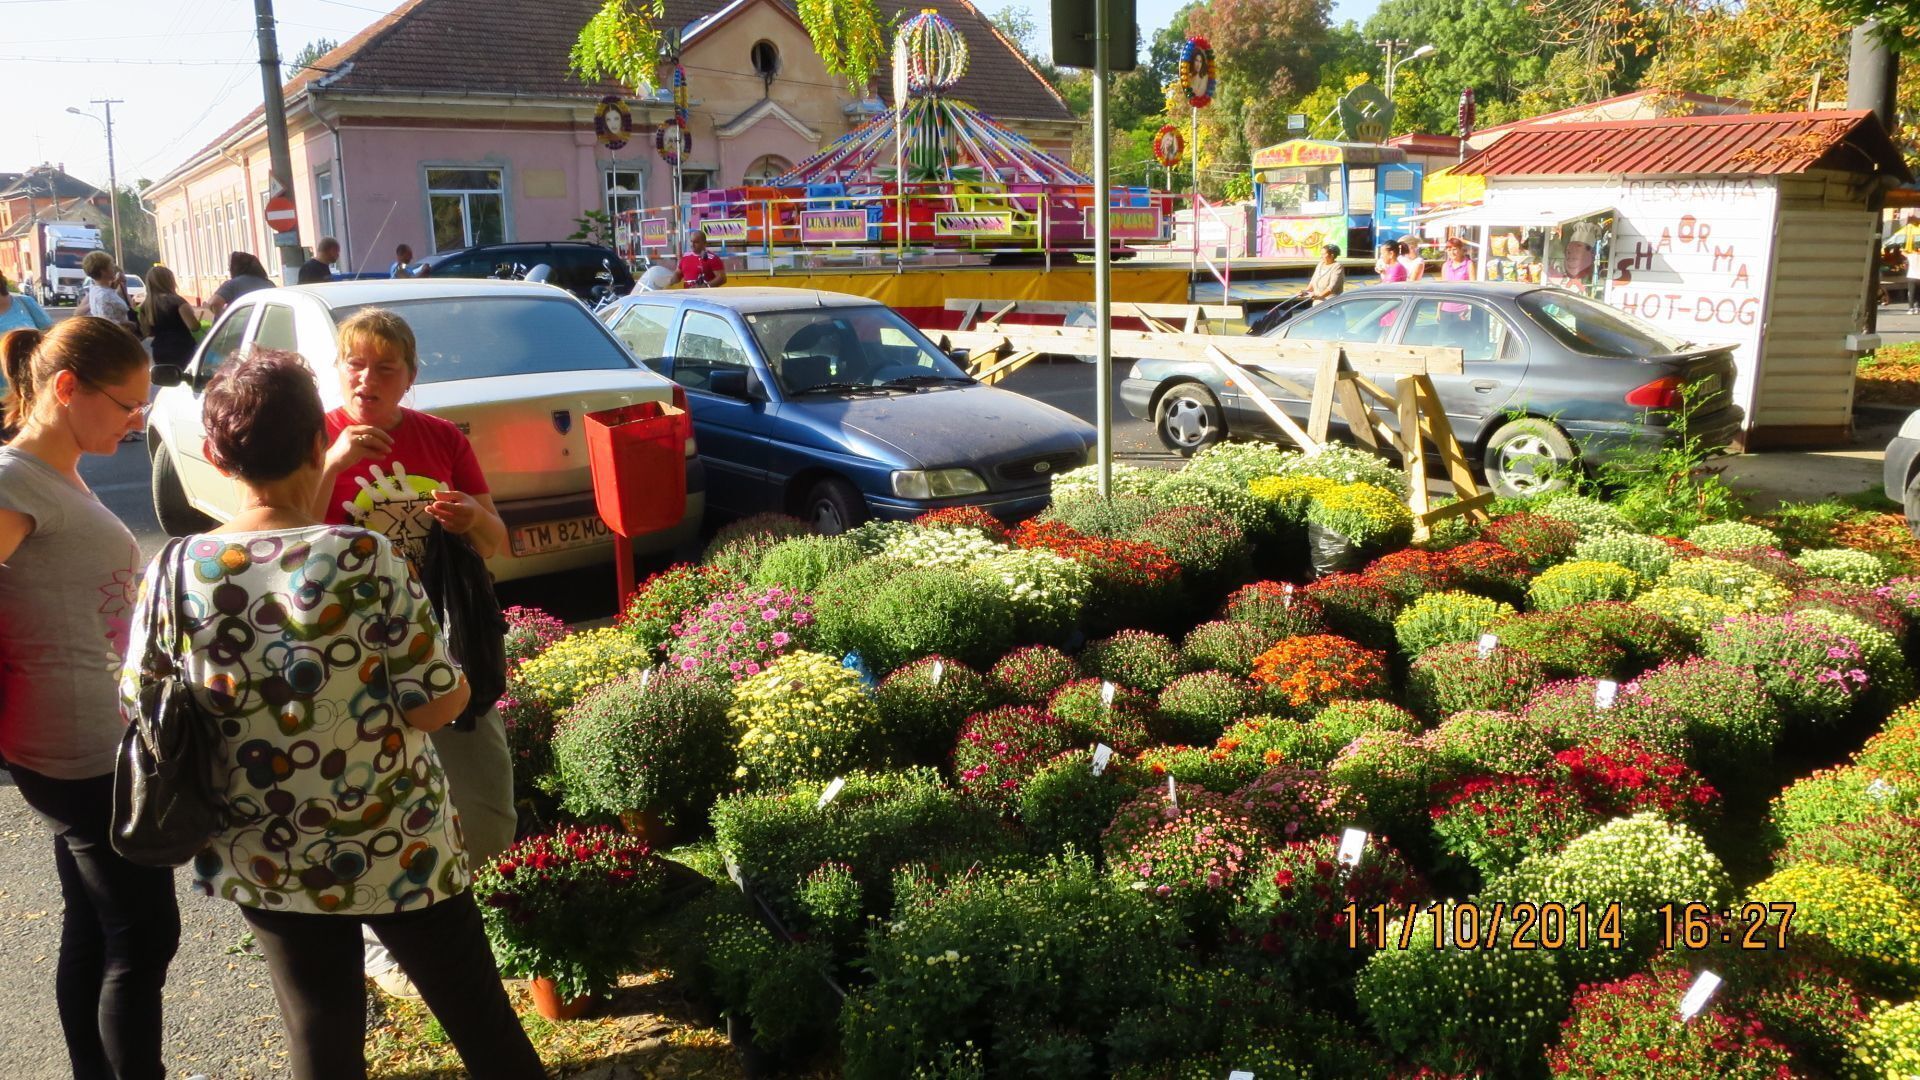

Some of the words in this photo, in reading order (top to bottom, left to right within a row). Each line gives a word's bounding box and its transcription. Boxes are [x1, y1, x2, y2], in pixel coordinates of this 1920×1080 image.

[806, 215, 831, 229] LUNA
[1612, 215, 1749, 289] SHAORMA
[1622, 292, 1760, 325] HOT-DOG
[525, 525, 552, 547] TM
[558, 521, 580, 541] 82
[583, 517, 614, 539] MO
